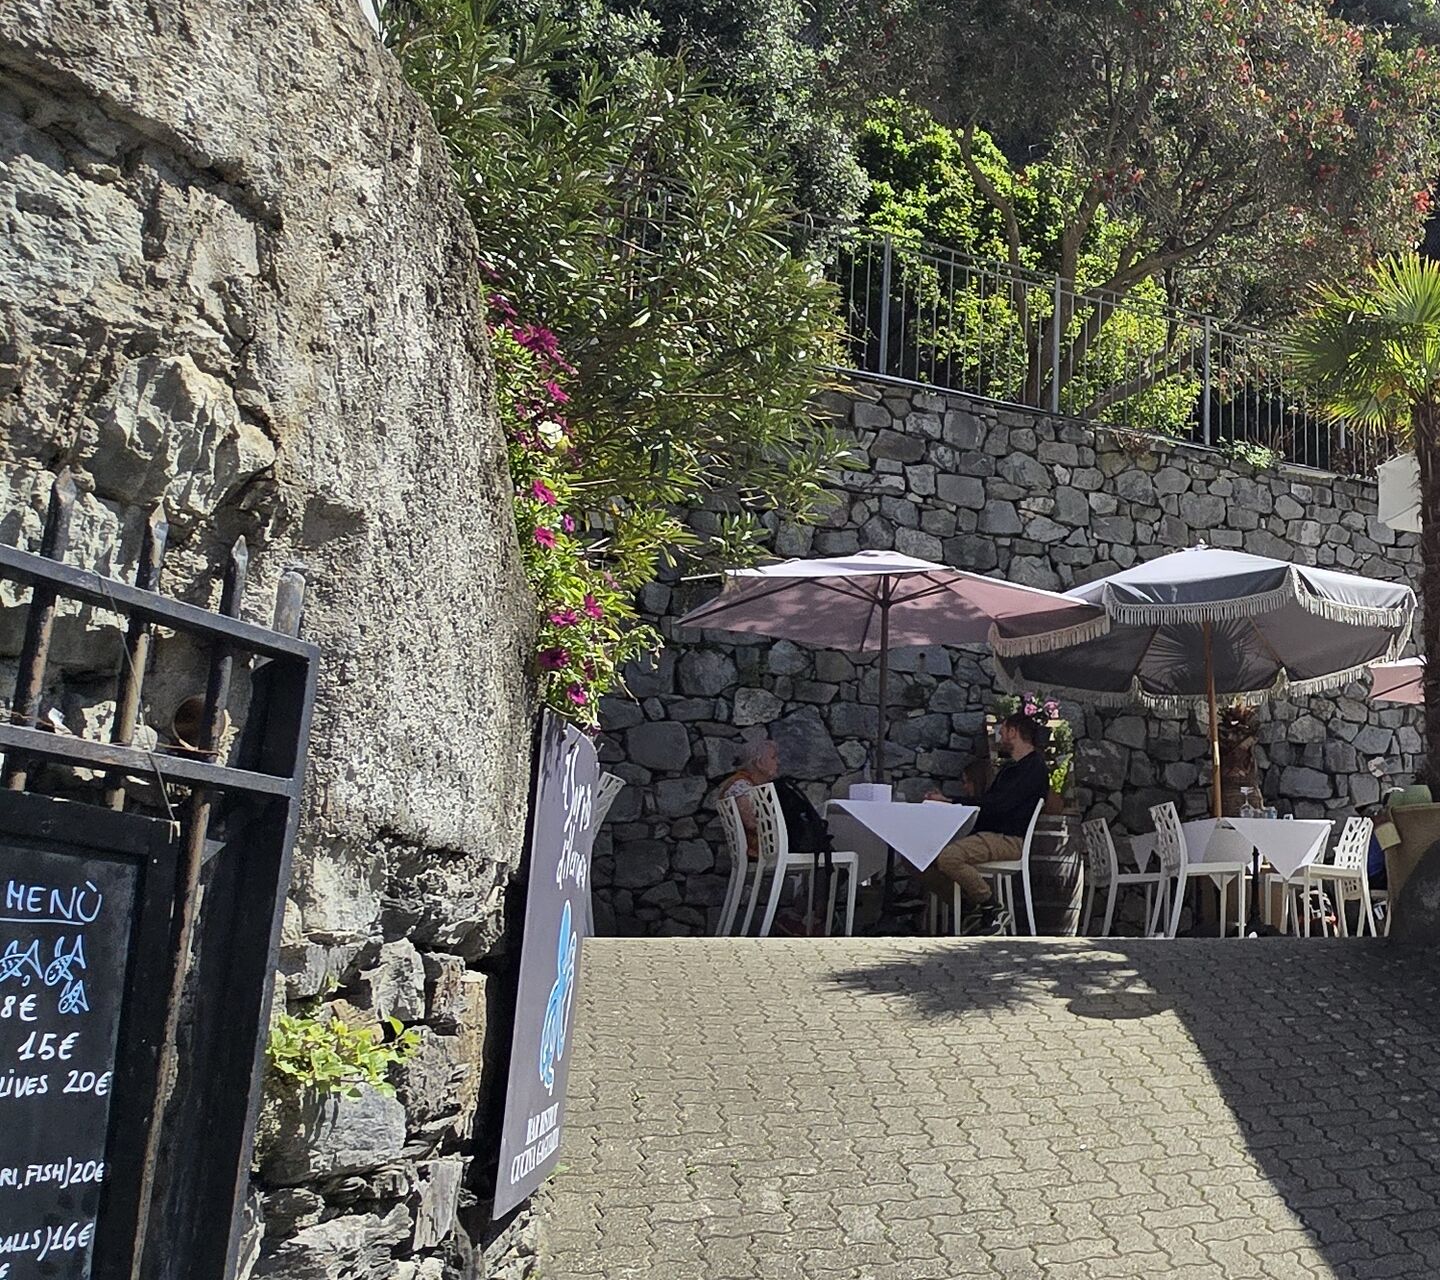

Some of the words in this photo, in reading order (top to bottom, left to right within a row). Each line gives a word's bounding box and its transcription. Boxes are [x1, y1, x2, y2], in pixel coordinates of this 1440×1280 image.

[6, 880, 102, 922] MENÙ
[17, 1031, 80, 1061] 15€
[63, 1070, 113, 1096] 20€
